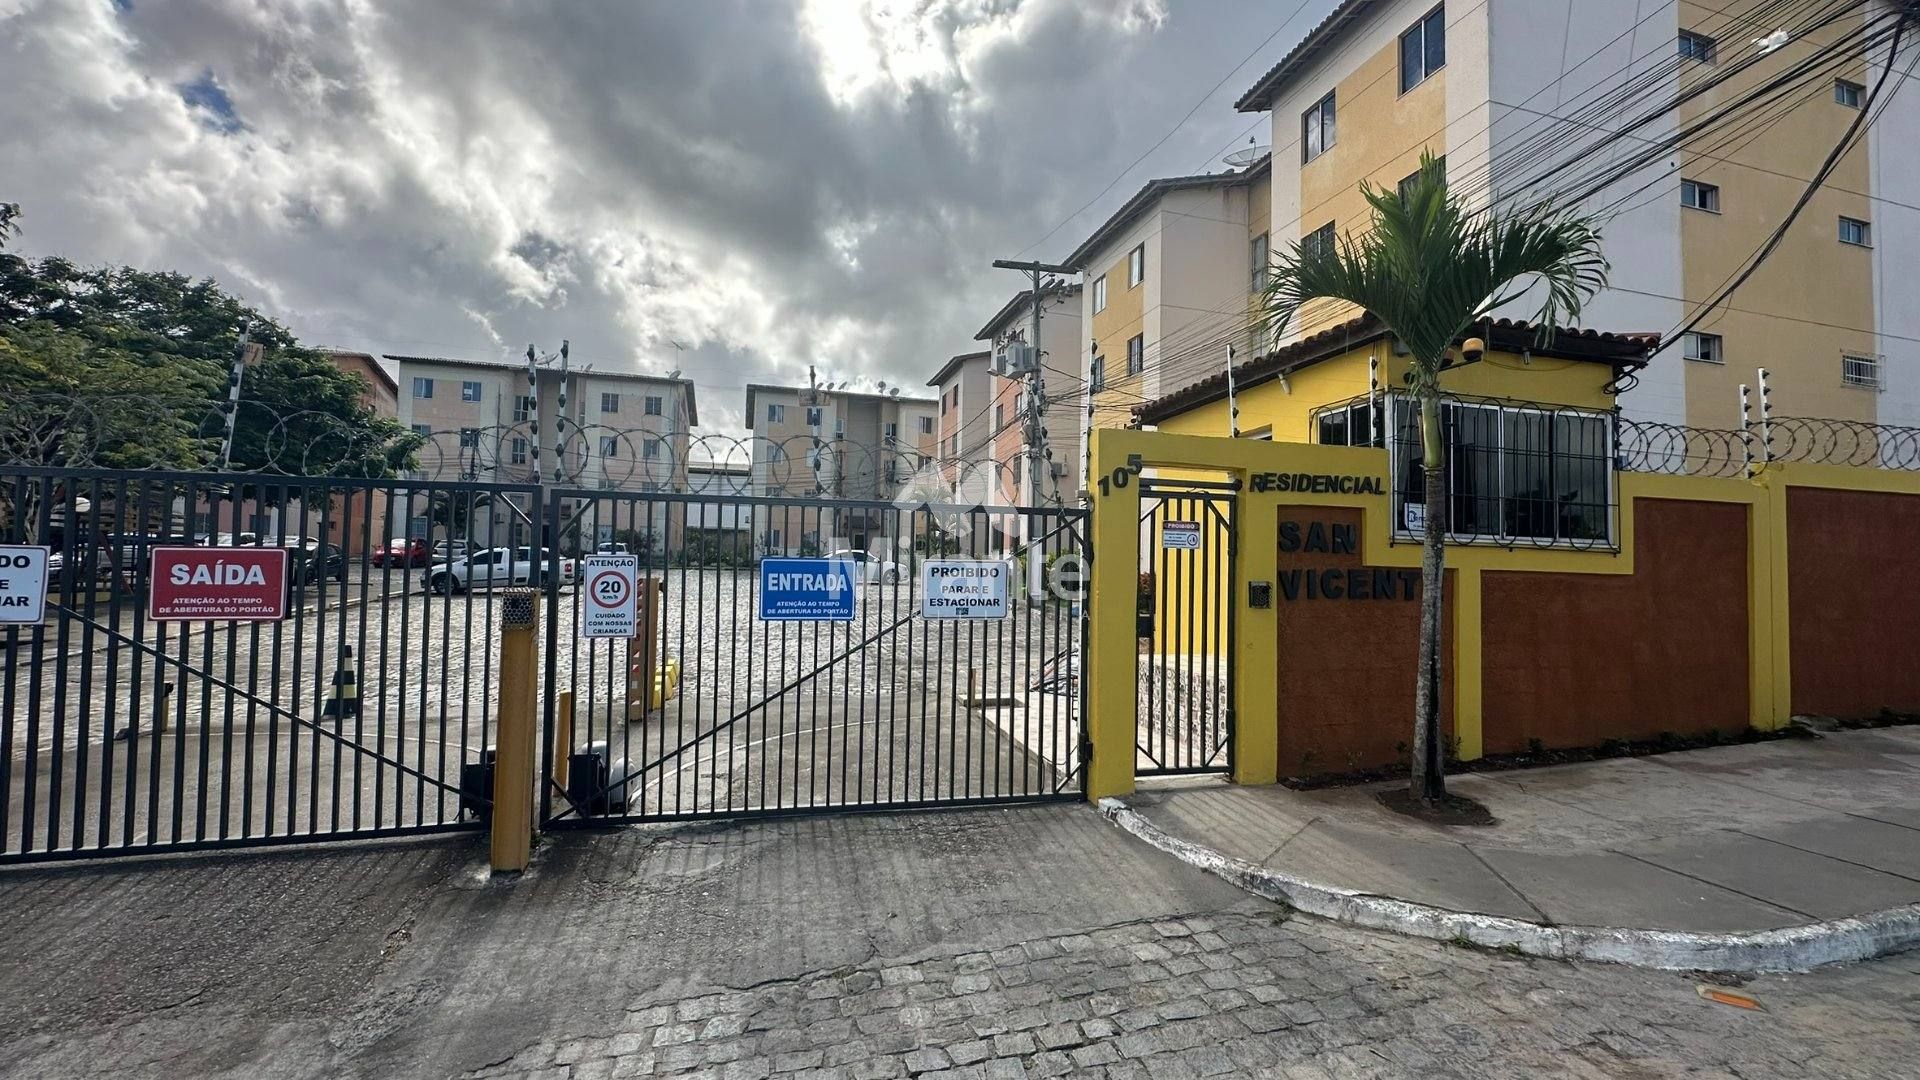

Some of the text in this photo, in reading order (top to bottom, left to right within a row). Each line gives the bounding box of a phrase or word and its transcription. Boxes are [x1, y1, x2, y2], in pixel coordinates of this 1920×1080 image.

[1097, 454, 1142, 496] 105
[1249, 472, 1386, 495] RESIDENCIAL
[1278, 521, 1356, 554] SAN
[588, 559, 633, 567] ATENÇÃO
[170, 559, 266, 586] SAÍDA
[931, 567, 999, 578] PROIBIDO
[600, 581, 621, 593] 20
[768, 573, 847, 591] ENTRADA
[1278, 567, 1424, 601] VICENT
[942, 585, 989, 594] PARAR E
[0, 596, 29, 607] AR
[172, 597, 215, 605] ATENÇÃO
[929, 598, 1000, 607] ESTACIONAR
